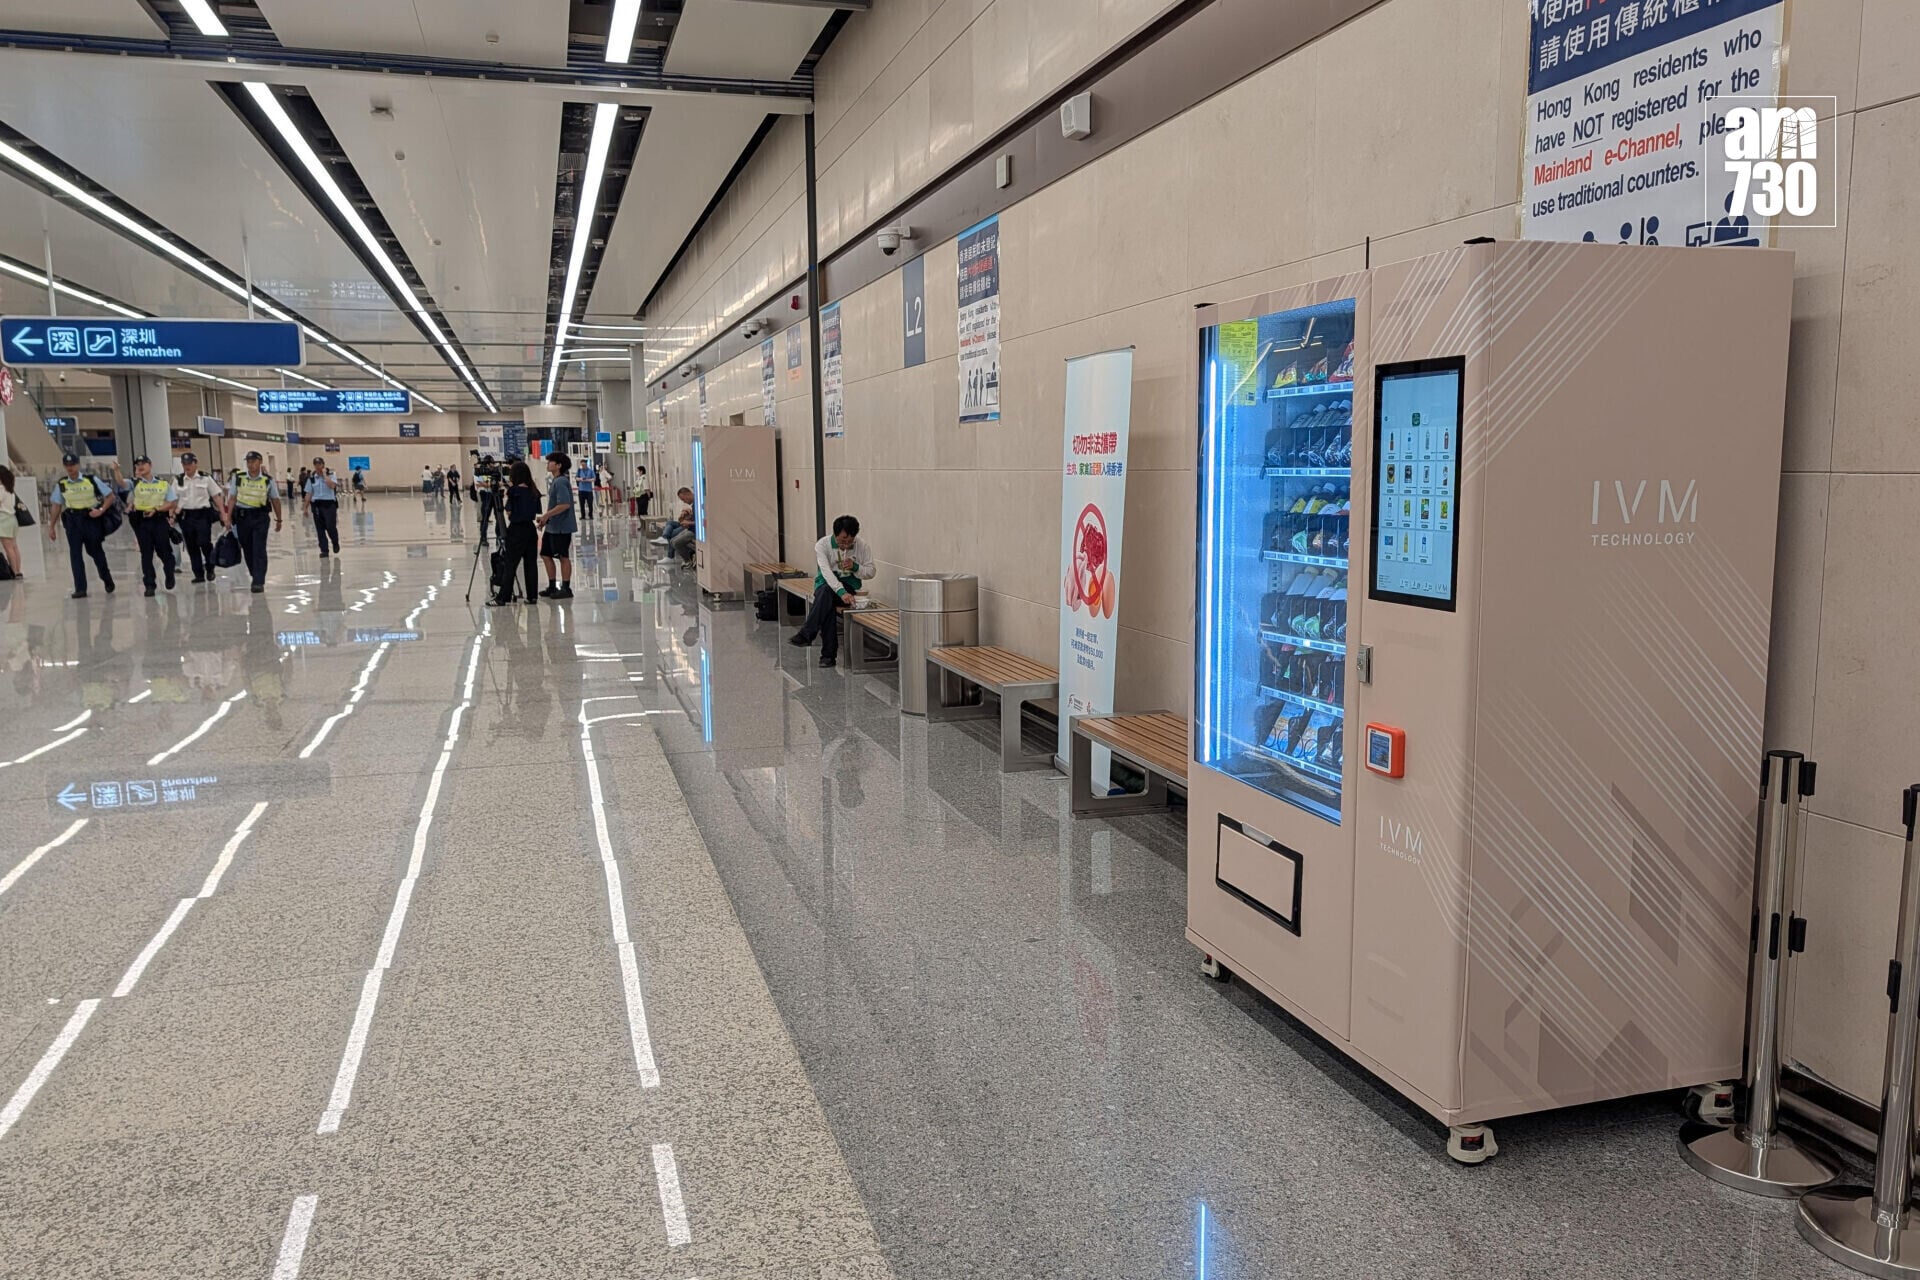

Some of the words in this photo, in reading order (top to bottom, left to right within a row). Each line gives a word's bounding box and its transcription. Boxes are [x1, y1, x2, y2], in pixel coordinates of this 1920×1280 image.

[1537, 96, 1572, 122] Hong
[1584, 78, 1620, 106] Kong
[1633, 46, 1708, 88] residents
[1724, 29, 1761, 58] who
[1535, 131, 1565, 154] have
[1573, 113, 1604, 143] NOT
[1612, 85, 1688, 131] registered
[1698, 79, 1722, 103] for
[1730, 67, 1760, 94] the
[1534, 150, 1593, 186] Mainland
[1604, 123, 1682, 166] e-Channel,
[1532, 198, 1555, 218] use
[1558, 174, 1624, 211] traditional
[1627, 160, 1700, 193] counters.
[120, 328, 156, 344] 深圳
[906, 296, 922, 337] L2
[52, 331, 76, 352] 深
[122, 346, 182, 357] Shenzhen
[1592, 480, 1698, 524] IVM
[1592, 532, 1695, 546] TECHNOLOGY
[1380, 816, 1422, 855] IVM
[1380, 842, 1421, 865] TECHNOLOGY
